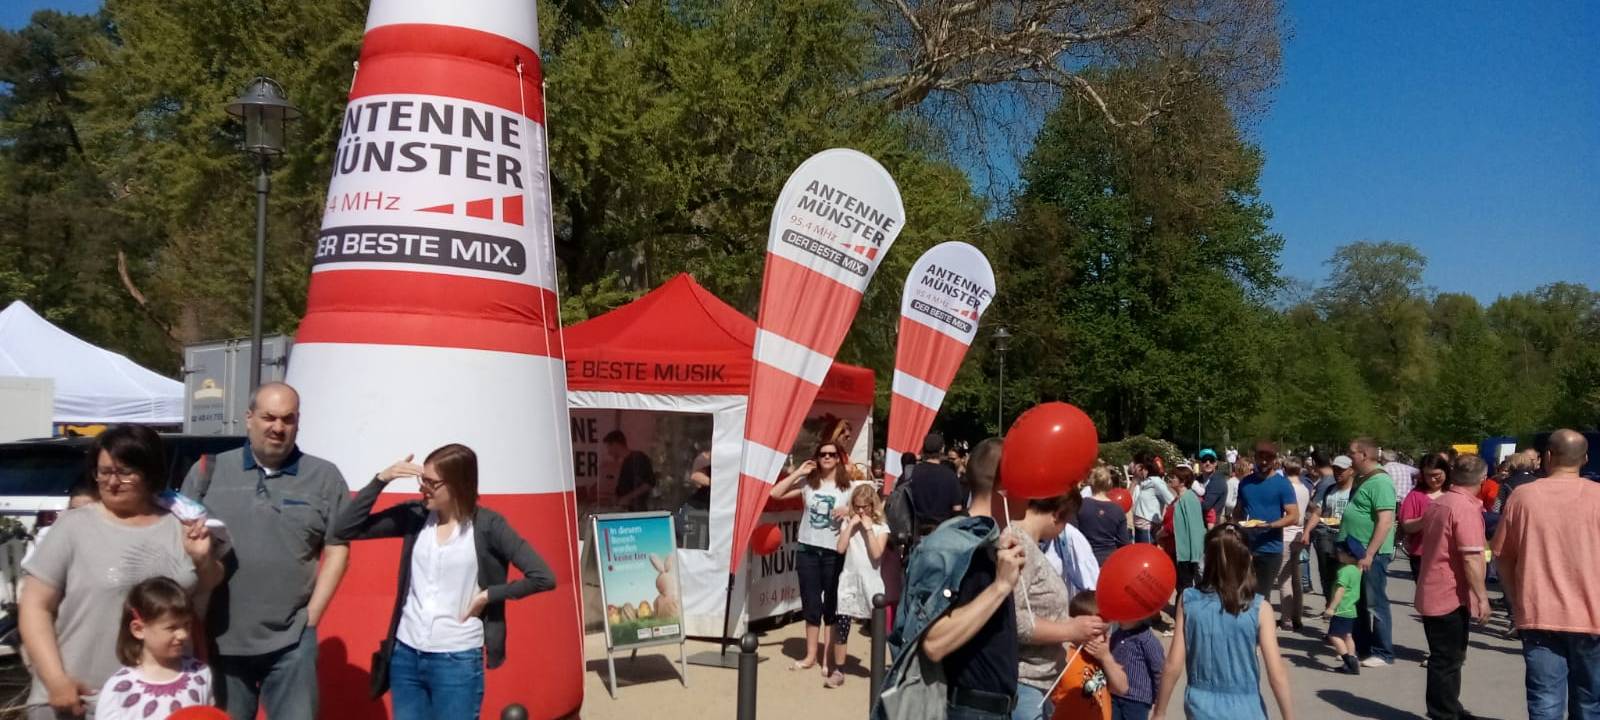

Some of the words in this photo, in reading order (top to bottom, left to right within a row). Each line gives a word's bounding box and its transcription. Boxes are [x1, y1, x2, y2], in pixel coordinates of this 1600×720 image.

[341, 191, 401, 212] MHz
[805, 179, 896, 233] ANTENNE
[797, 195, 886, 247] MÜNSTER
[314, 235, 338, 258] ER
[341, 233, 440, 258] BESTE
[450, 238, 519, 267] MIX.
[787, 232, 809, 249] DER
[811, 243, 841, 264] BESTE
[920, 275, 981, 312] MÜNSTER
[926, 263, 992, 301] ANTENNE
[914, 301, 930, 313] DER
[583, 360, 648, 381] BESTE
